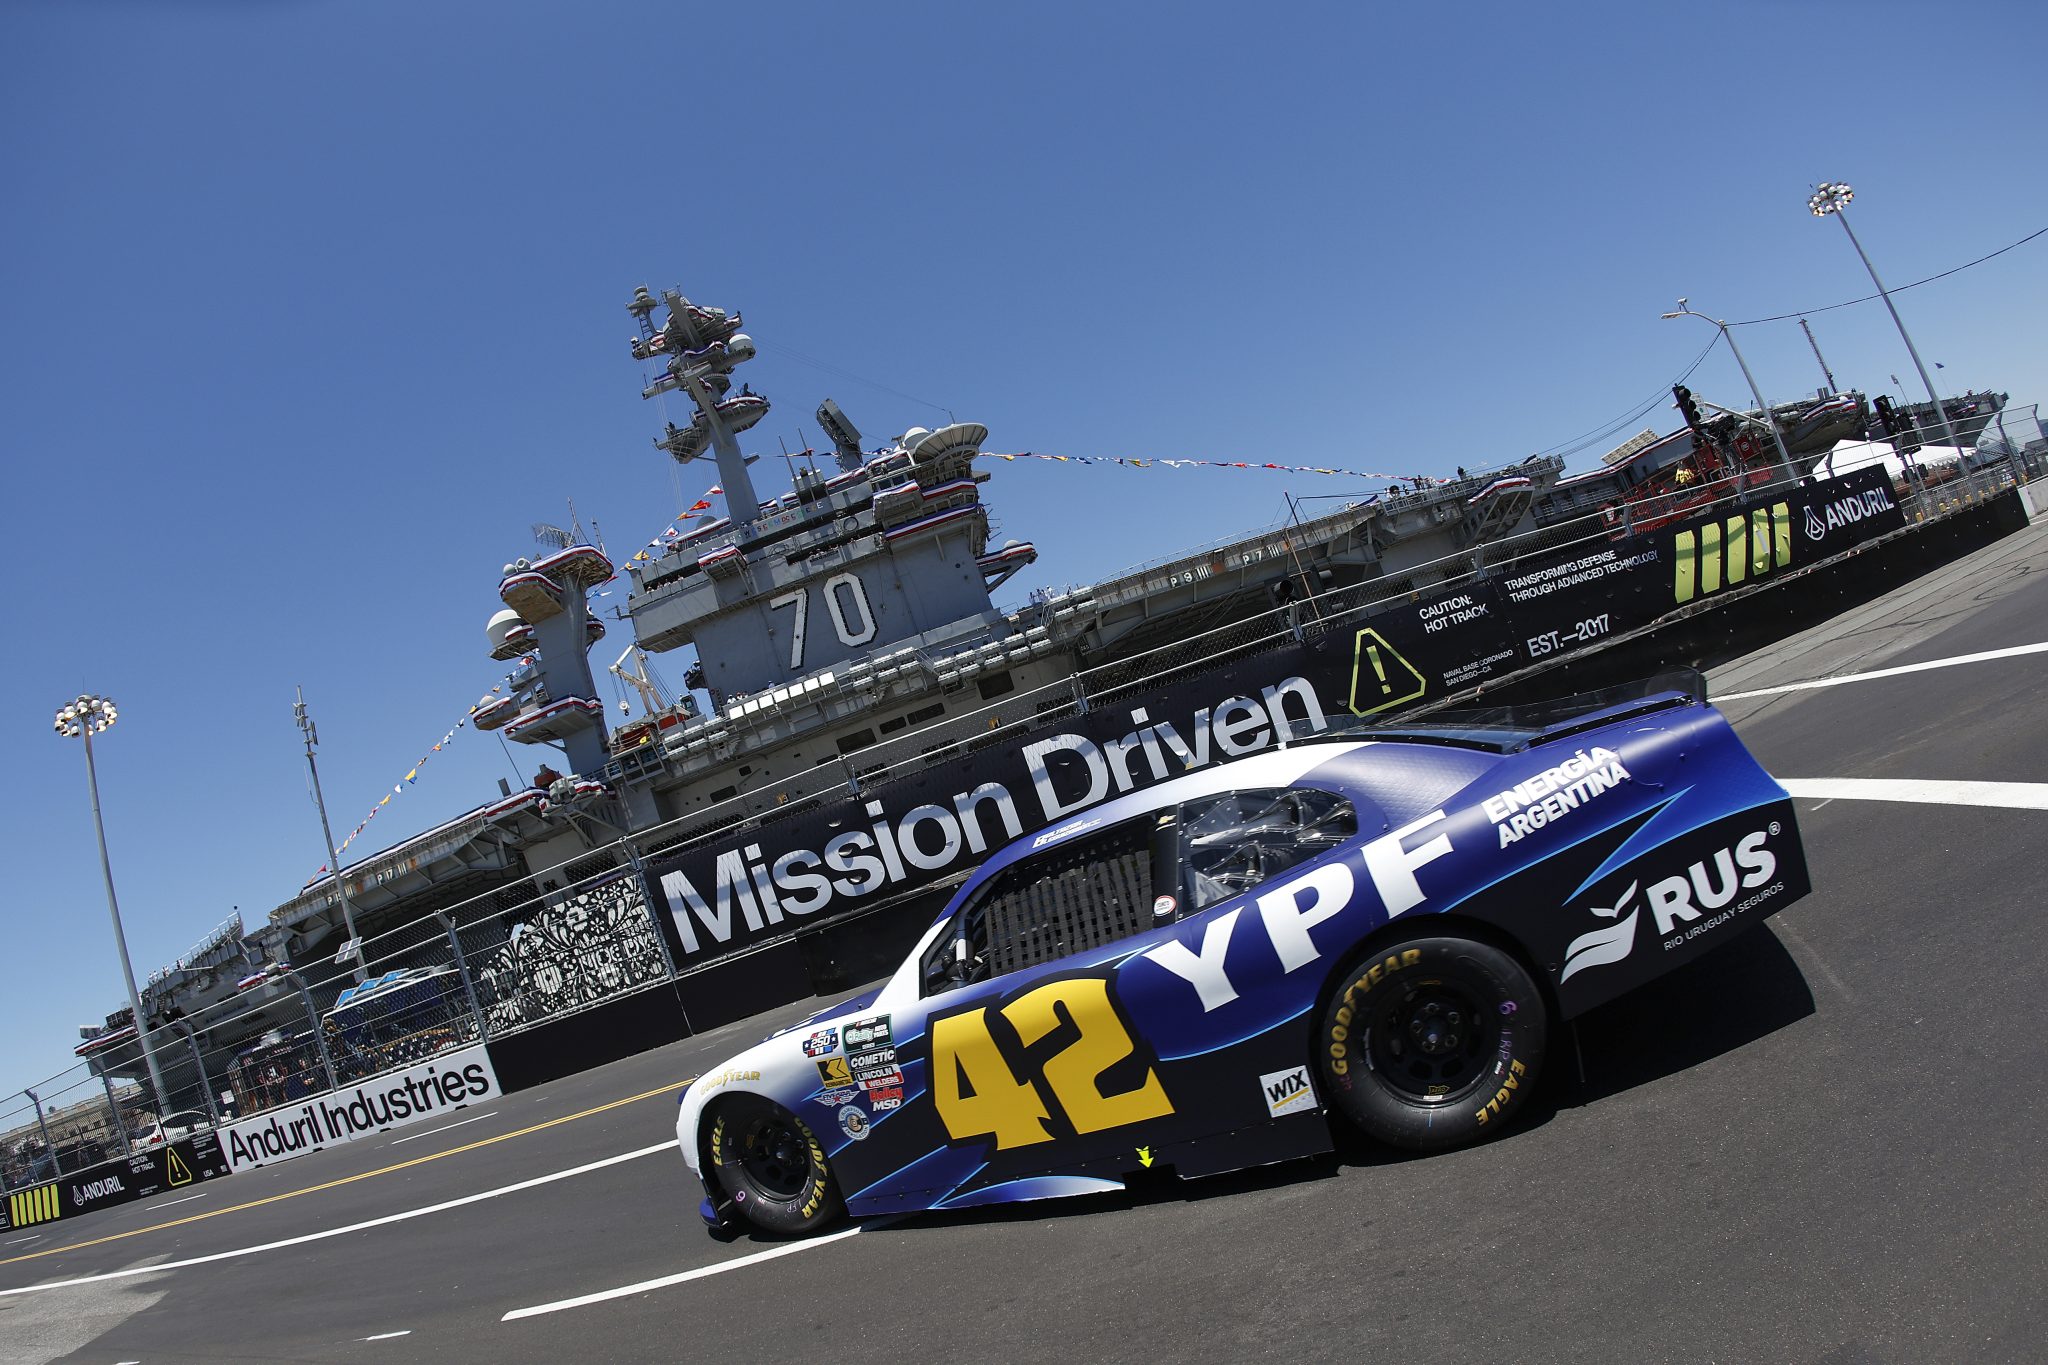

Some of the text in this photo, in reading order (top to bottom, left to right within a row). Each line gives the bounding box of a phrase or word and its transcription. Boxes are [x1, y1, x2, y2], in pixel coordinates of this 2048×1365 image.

[1825, 487, 1895, 531] ANDURIL
[1504, 550, 1617, 591] TRANSFORMING DEFENSE
[1509, 550, 1659, 603] THROUGH ADVANCED TECHNOLOGY
[769, 572, 879, 670] 70
[1419, 594, 1473, 620] CAUTION:
[1424, 603, 1489, 634] HOT TRACK
[1443, 649, 1514, 680] NAVAL BASE CORONADO
[1445, 675, 1458, 687] SAN
[1481, 746, 1620, 825] ENERGÍA
[1498, 761, 1632, 850] ARGENTINA
[660, 676, 1328, 955] Mission Driven
[1141, 808, 1455, 1014] YPF
[1663, 881, 1785, 951] RIO URUGUAY SEGUROS
[1329, 948, 1422, 1076] GOODYEAR
[810, 1035, 831, 1049] 250
[850, 1050, 895, 1068] COMETIC
[857, 1066, 893, 1081] LINCOLN
[867, 1075, 899, 1087] WELDERS
[932, 978, 1176, 1151] 42
[1267, 1069, 1309, 1103] WIX
[318, 1063, 491, 1140] Industries
[869, 1087, 904, 1102] Holley
[873, 1098, 901, 1111] MSD
[1475, 1058, 1527, 1127] EAGLE
[229, 1104, 325, 1168] Anduril
[712, 1116, 726, 1167] EAGLE
[82, 1175, 125, 1201] ANDURIL
